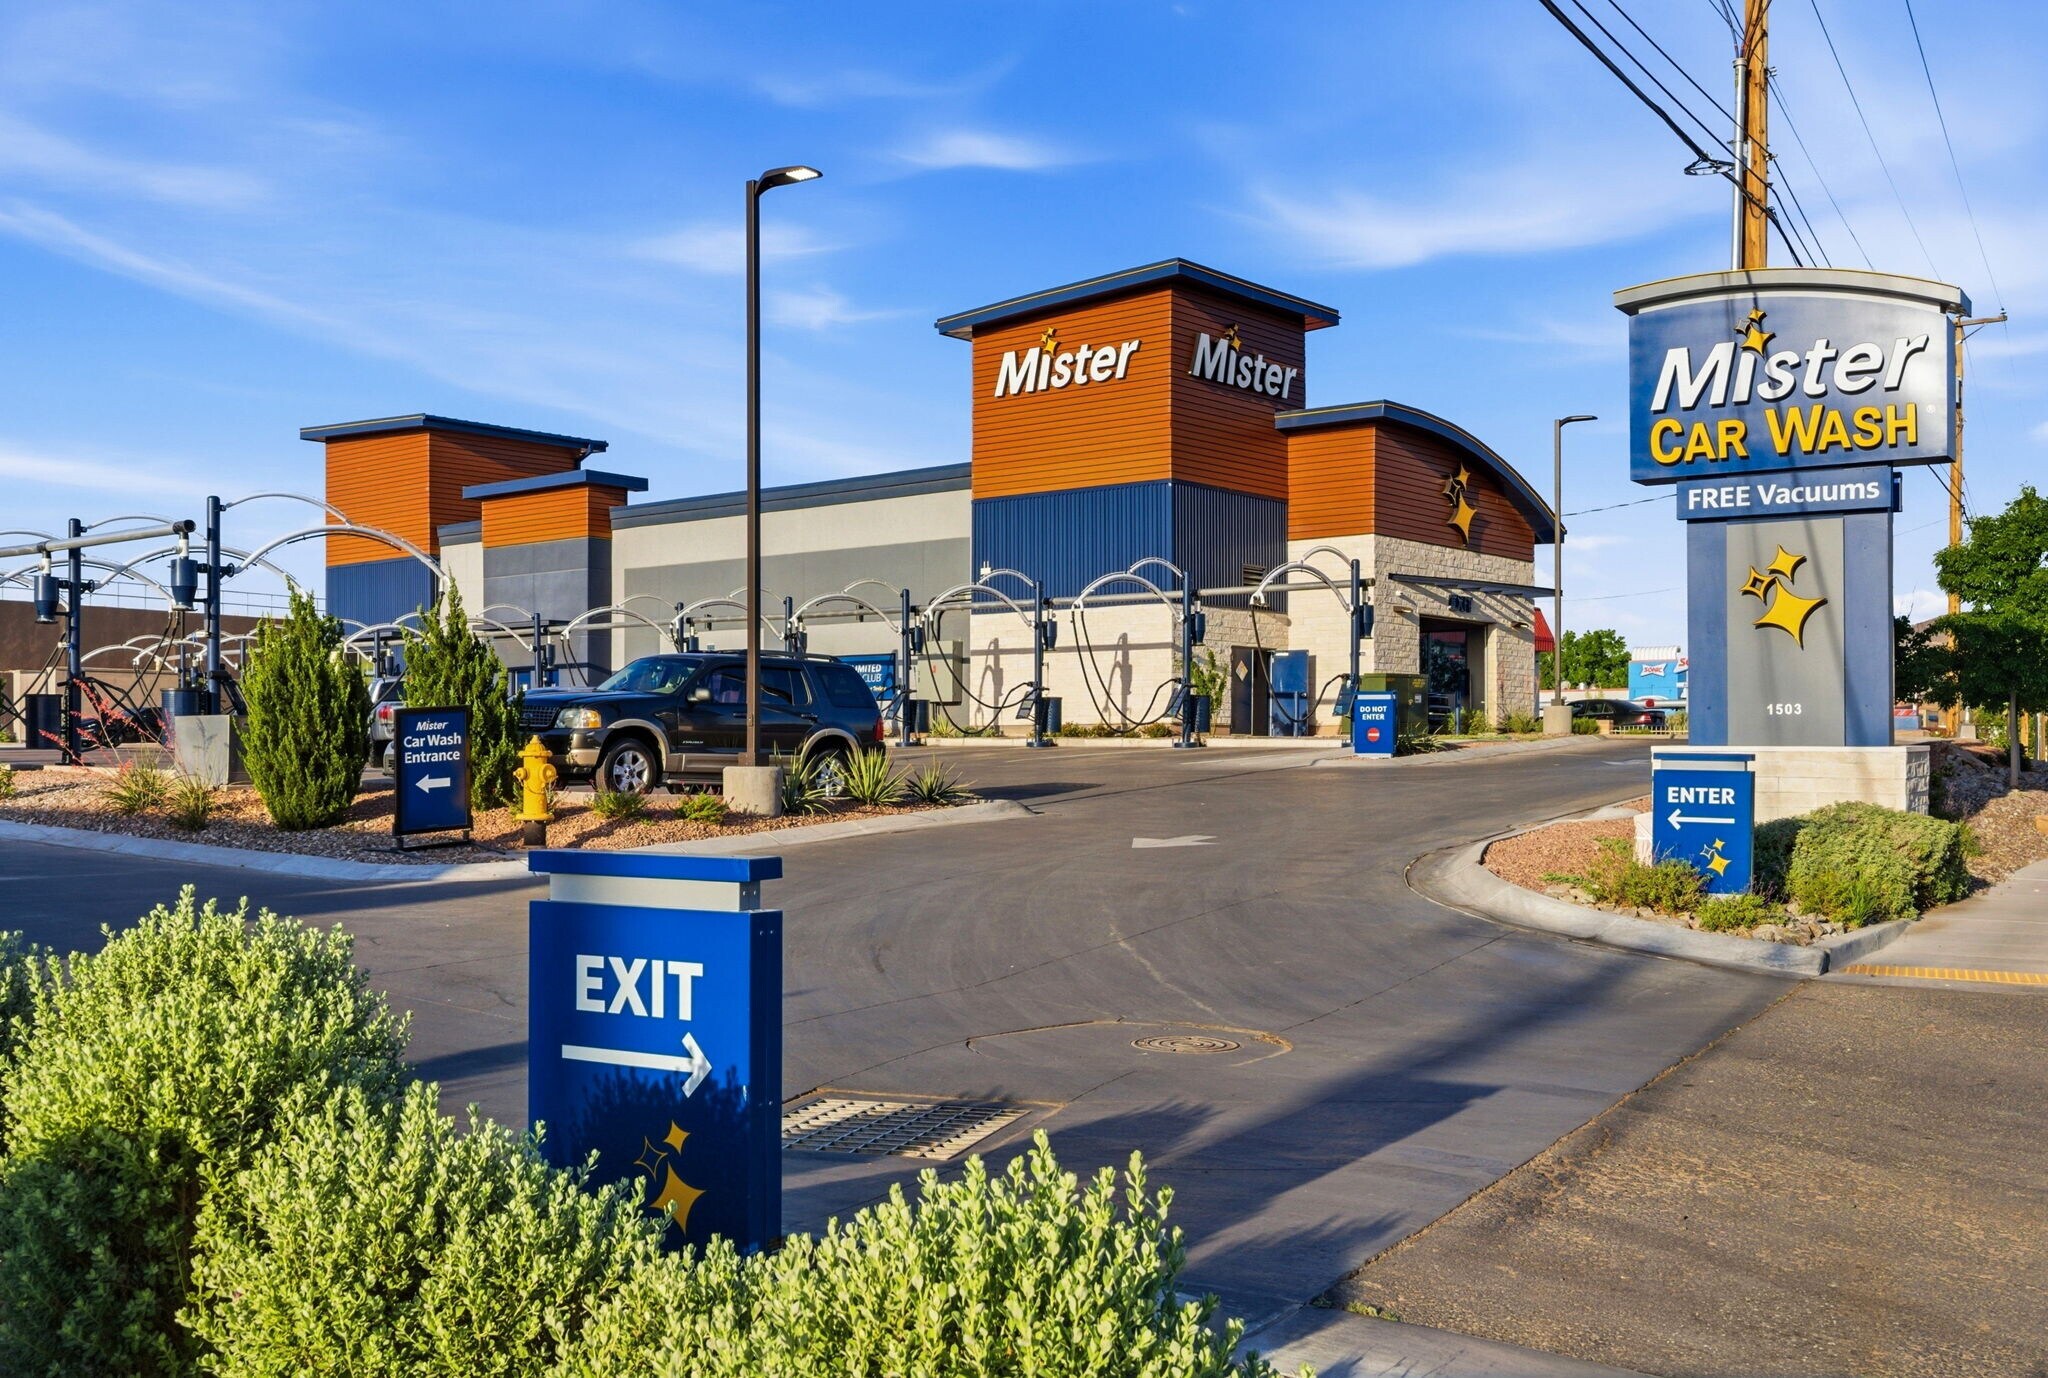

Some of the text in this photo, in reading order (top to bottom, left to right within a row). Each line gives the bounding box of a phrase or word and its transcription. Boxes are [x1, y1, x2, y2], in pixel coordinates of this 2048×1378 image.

[994, 339, 1141, 398] Mister
[1192, 332, 1298, 399] Mister
[1650, 333, 1930, 413] Mister
[1650, 402, 1919, 466] CAR WASH
[1688, 480, 1881, 511] FREE Vacuums
[855, 664, 882, 673] IMITED
[1362, 713, 1385, 721] ENTER
[1766, 703, 1802, 715] 1503
[416, 720, 448, 732] Mister
[403, 732, 462, 748] Car Wash
[404, 750, 461, 764] Entrance
[1667, 786, 1736, 805] ENTER
[575, 953, 704, 1022] EXIT
